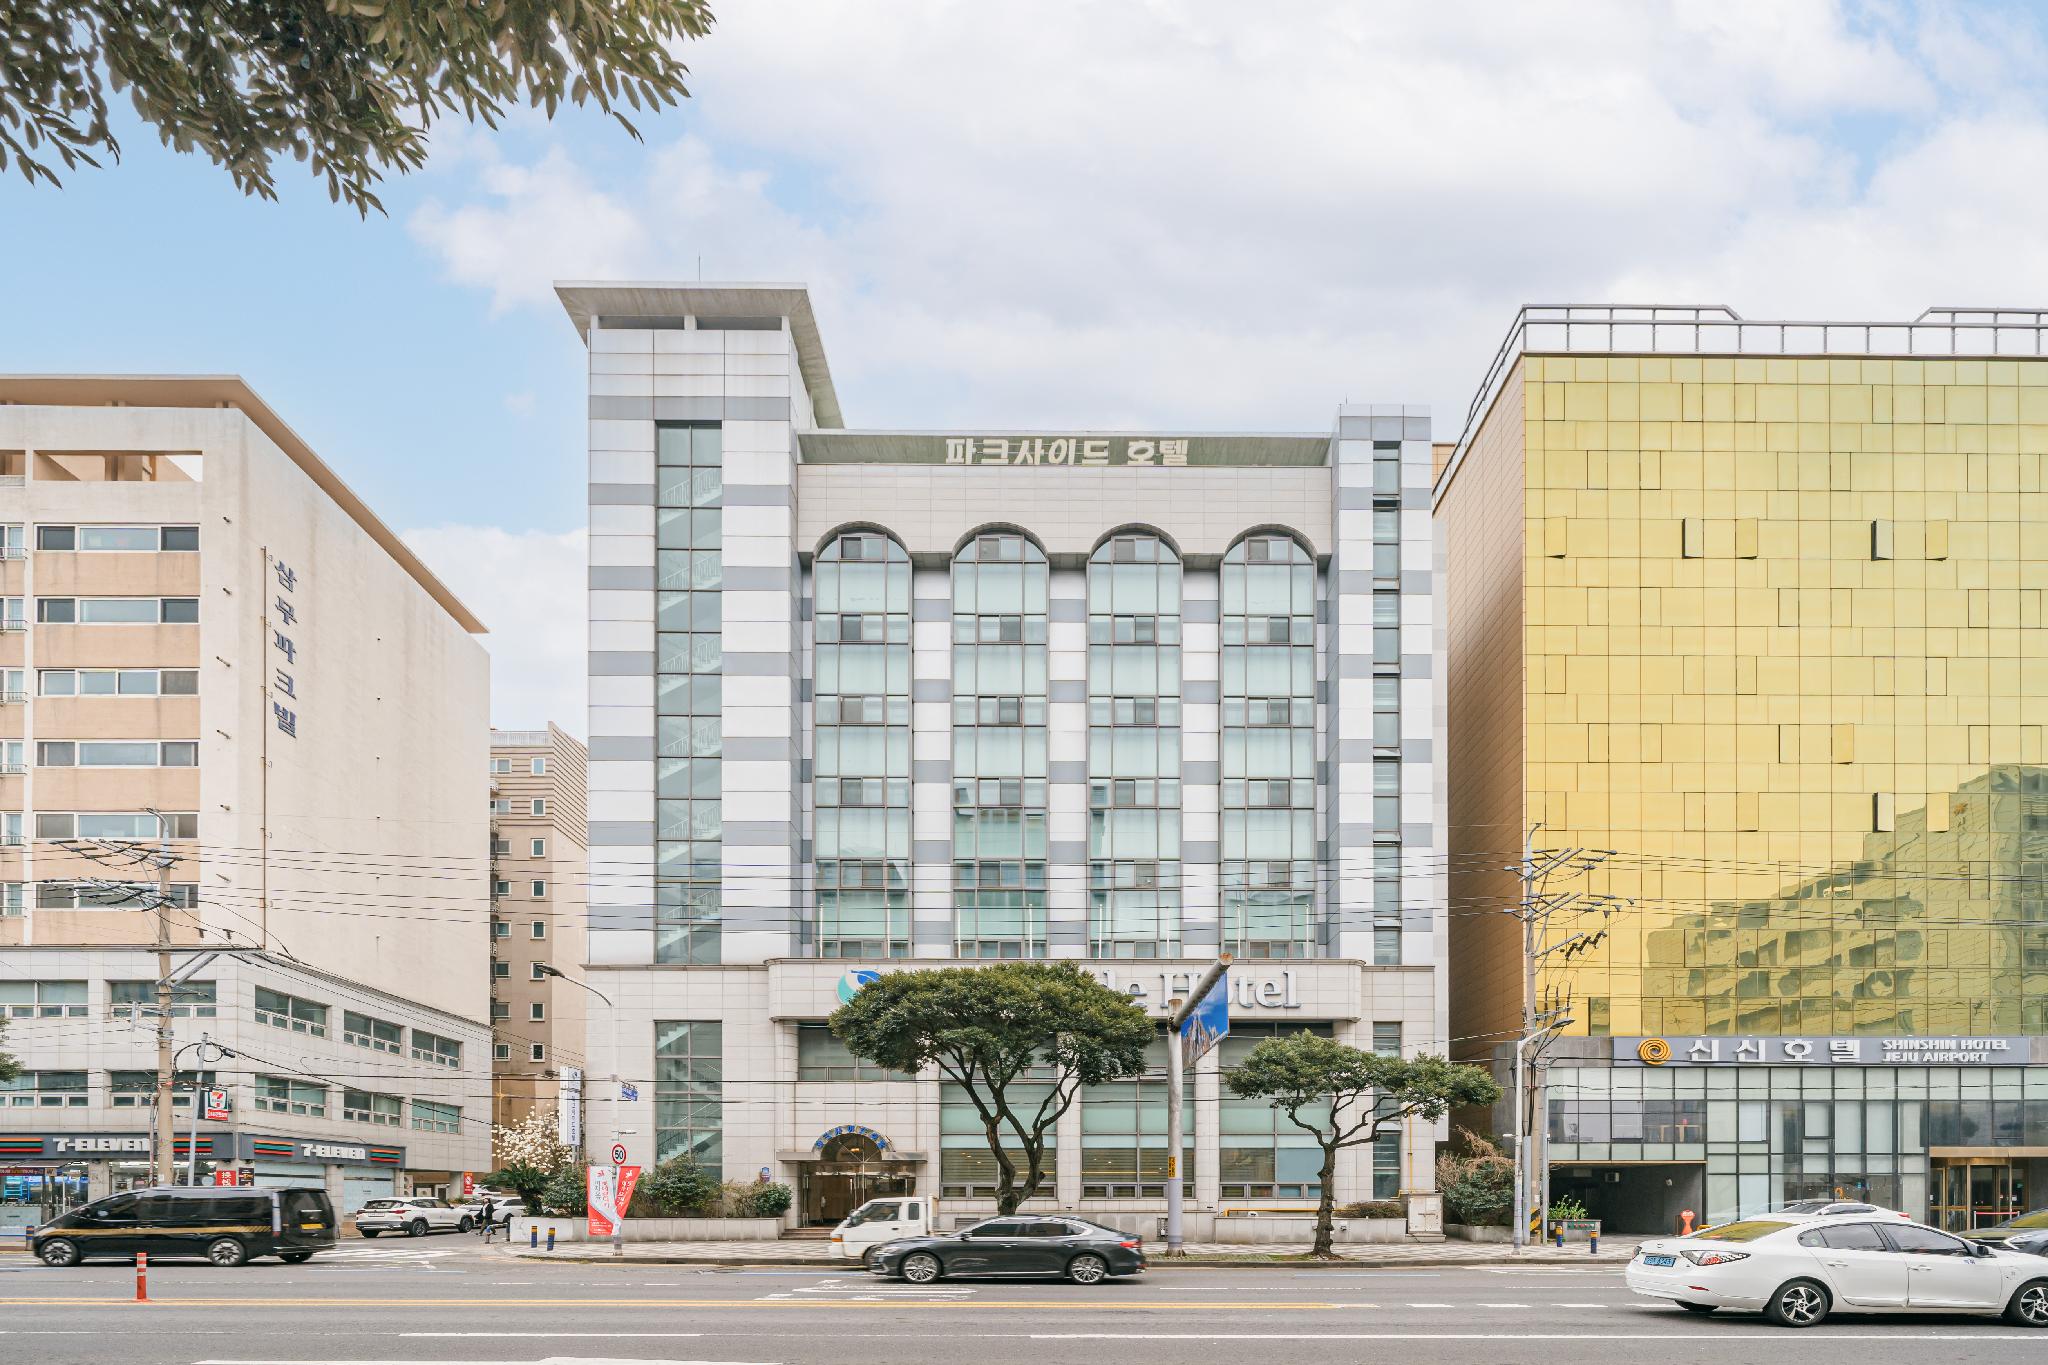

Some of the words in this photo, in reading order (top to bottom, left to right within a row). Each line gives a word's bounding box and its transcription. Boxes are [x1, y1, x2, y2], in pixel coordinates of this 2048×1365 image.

[945, 438, 1110, 466] 파크사이드
[1127, 439, 1189, 466] 호텔
[1160, 969, 1301, 1009] Htel
[1688, 1039, 1861, 1063] 신신호텔
[1882, 1039, 1957, 1050] SHINSHIN
[1960, 1039, 2010, 1050] HOTEL
[1882, 1051, 1919, 1062] JEJU
[1922, 1051, 1989, 1062] AIRPORT
[614, 1149, 624, 1160] 50
